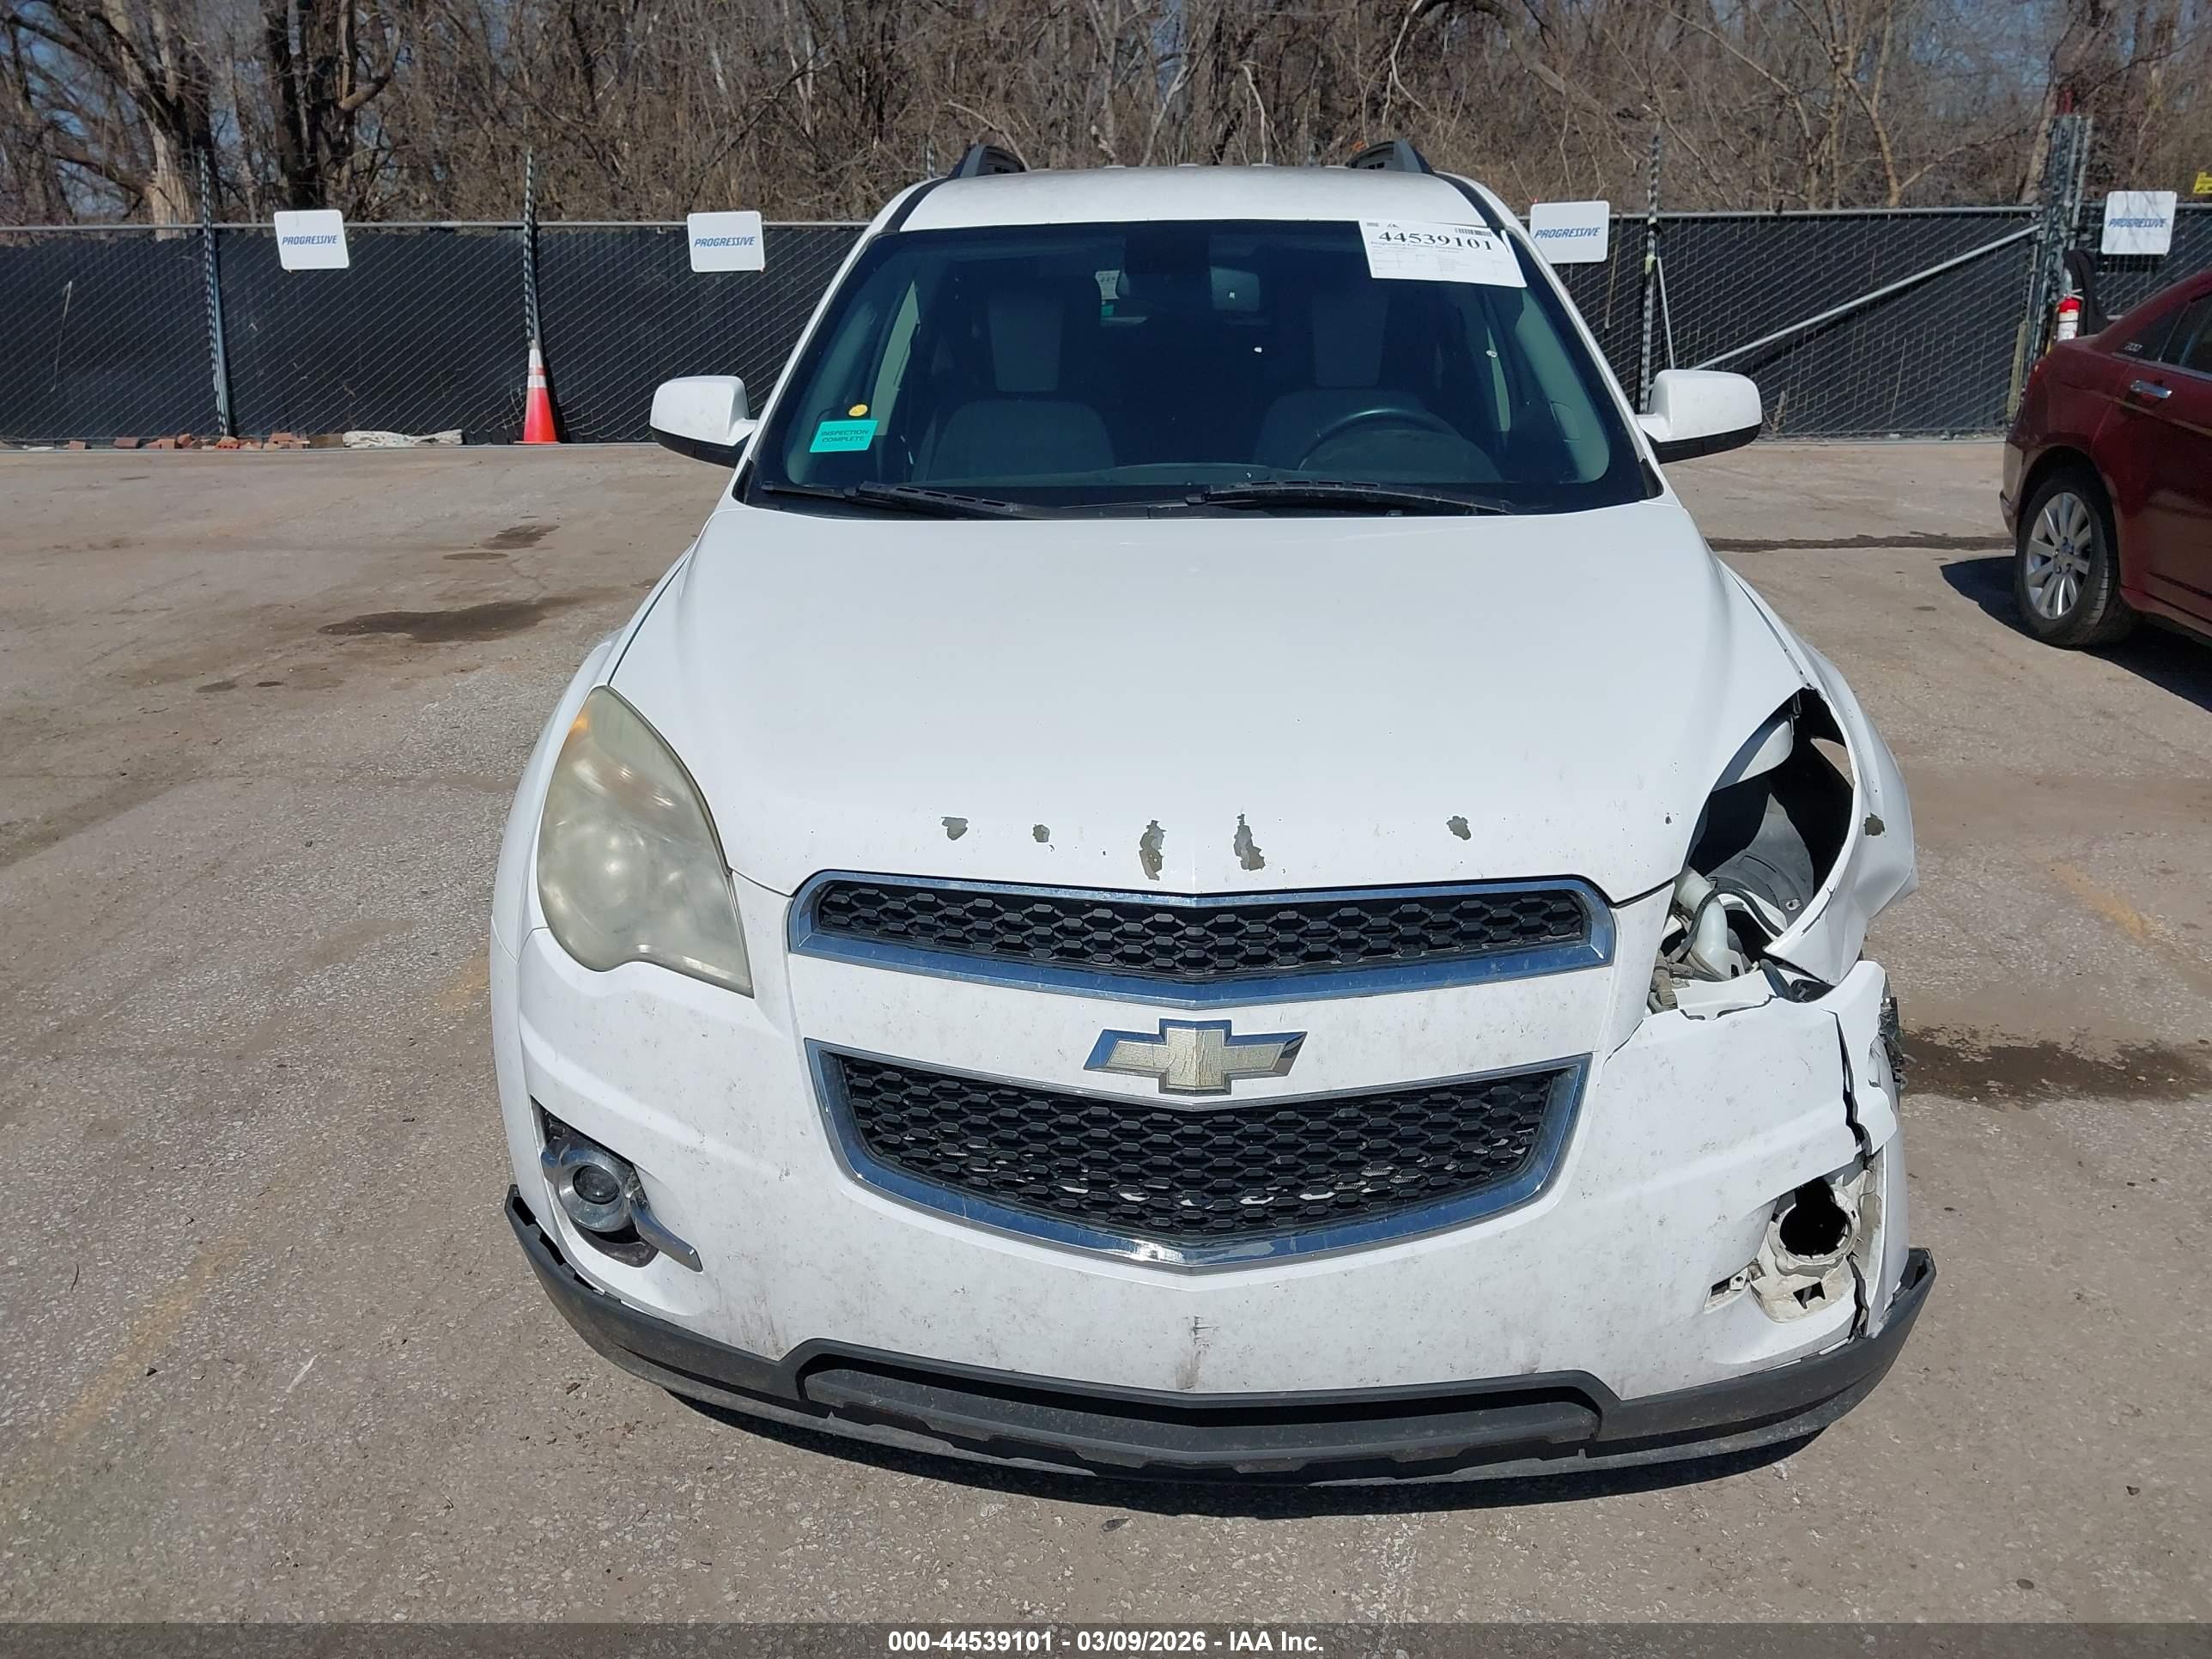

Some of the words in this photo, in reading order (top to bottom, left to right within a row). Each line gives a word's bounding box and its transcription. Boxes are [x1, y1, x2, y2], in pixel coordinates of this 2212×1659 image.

[1534, 227, 1601, 239] PROGRESSIVE
[282, 234, 337, 246] PROGRESSIVE
[693, 236, 756, 247] PROGRESSIVE
[1378, 231, 1493, 251] 44539101
